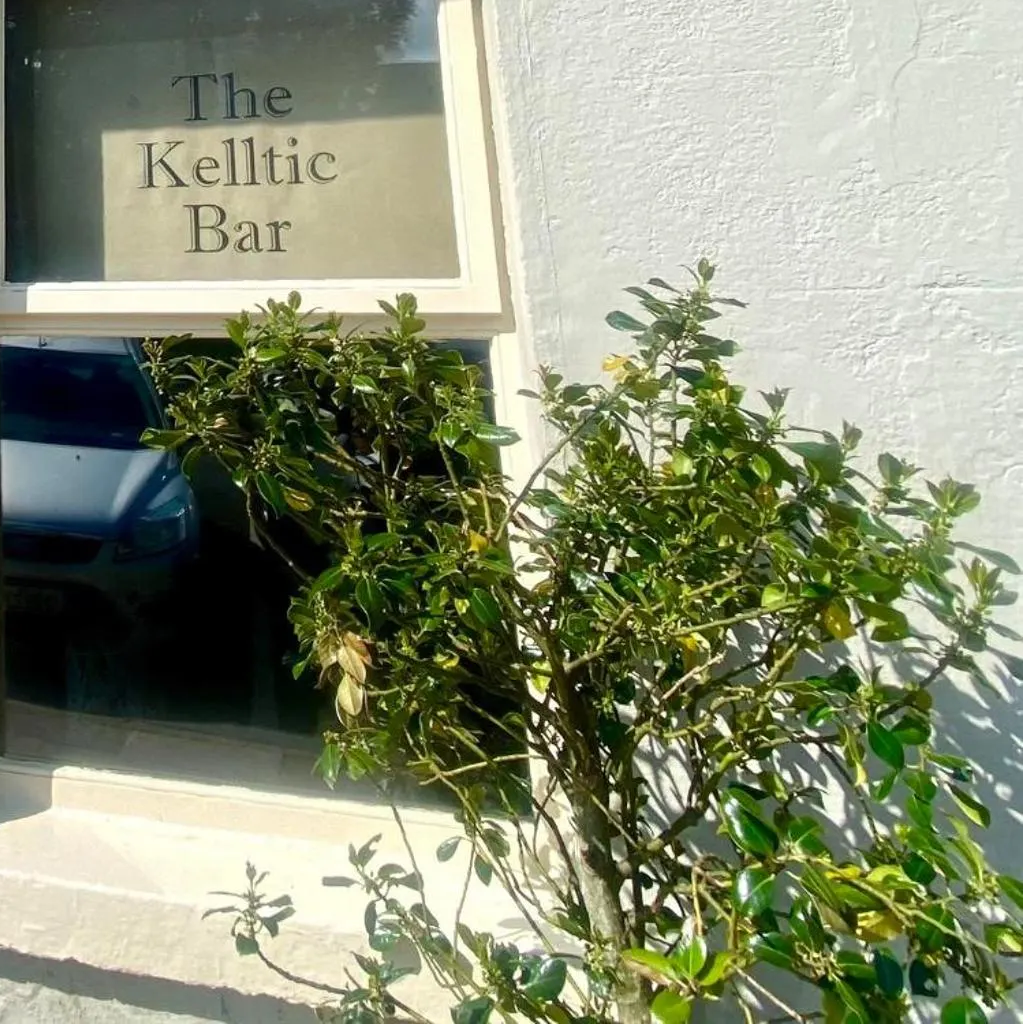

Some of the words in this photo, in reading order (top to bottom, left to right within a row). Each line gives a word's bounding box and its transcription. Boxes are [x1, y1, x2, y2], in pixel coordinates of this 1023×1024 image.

[171, 71, 294, 122] The
[136, 136, 339, 190] Kelltic
[184, 203, 292, 255] Bar
